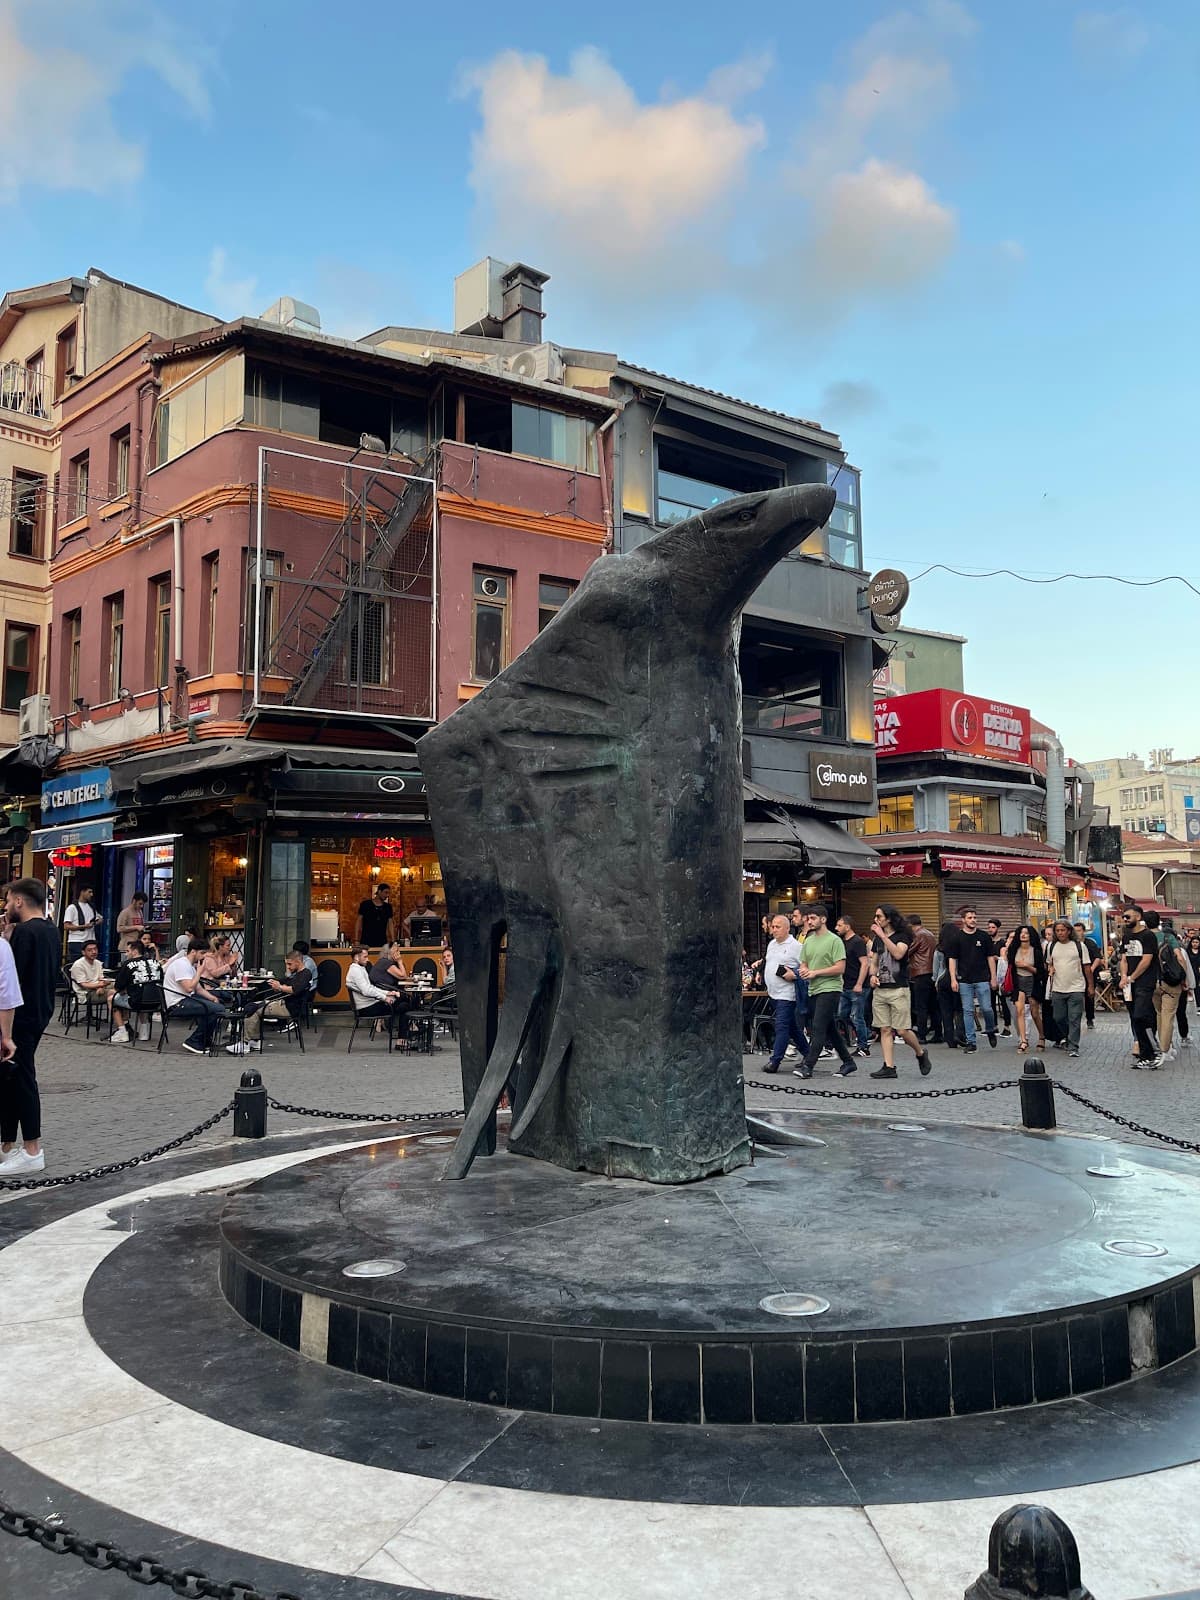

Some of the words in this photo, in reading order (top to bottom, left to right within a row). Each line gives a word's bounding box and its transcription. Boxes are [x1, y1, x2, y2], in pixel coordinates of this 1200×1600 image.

[875, 580, 895, 592] elma
[871, 590, 899, 605] lounge
[873, 702, 888, 711] TAŞ
[983, 712, 1023, 736] DERYA
[984, 729, 1021, 752] BALIK
[822, 767, 847, 783] elma
[849, 771, 868, 787] pub
[52, 790, 71, 808] CEM
[72, 783, 101, 805] TEKEL
[374, 848, 389, 858] Red
[389, 849, 403, 859] Bull
